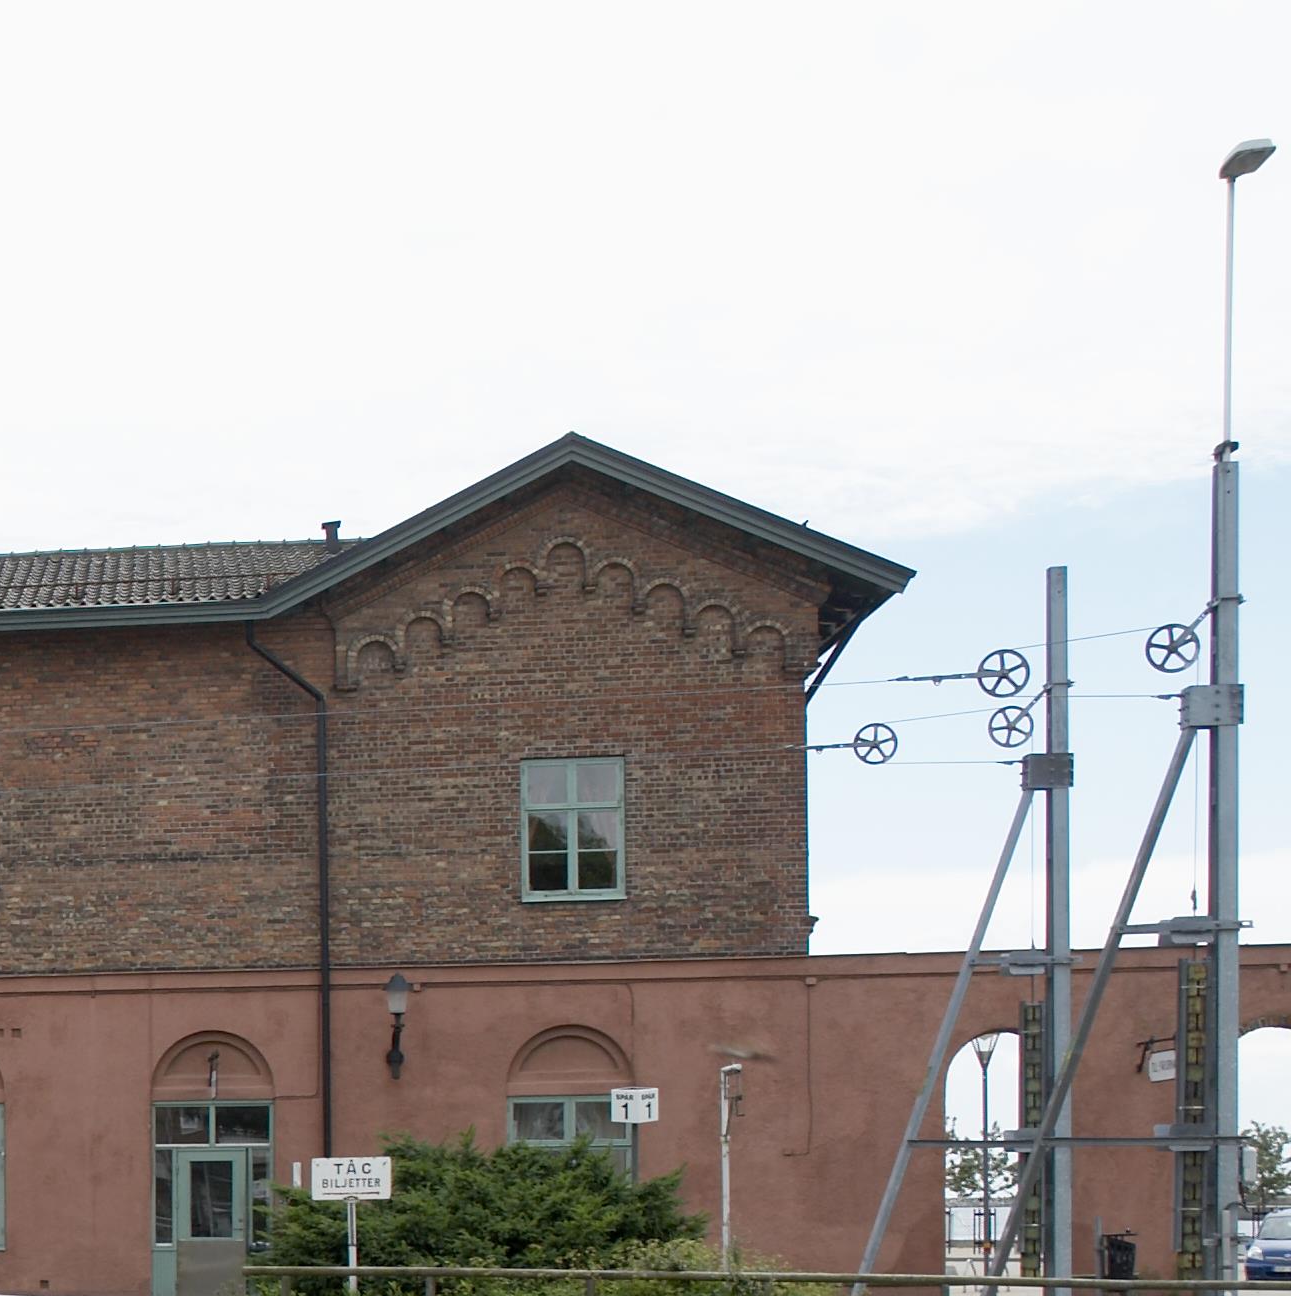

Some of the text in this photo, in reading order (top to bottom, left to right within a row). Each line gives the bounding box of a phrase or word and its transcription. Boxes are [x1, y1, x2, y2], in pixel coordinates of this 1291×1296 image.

[621, 1102, 629, 1120] 1
[645, 1101, 652, 1119] 1
[322, 1178, 381, 1189] BILJETTER
